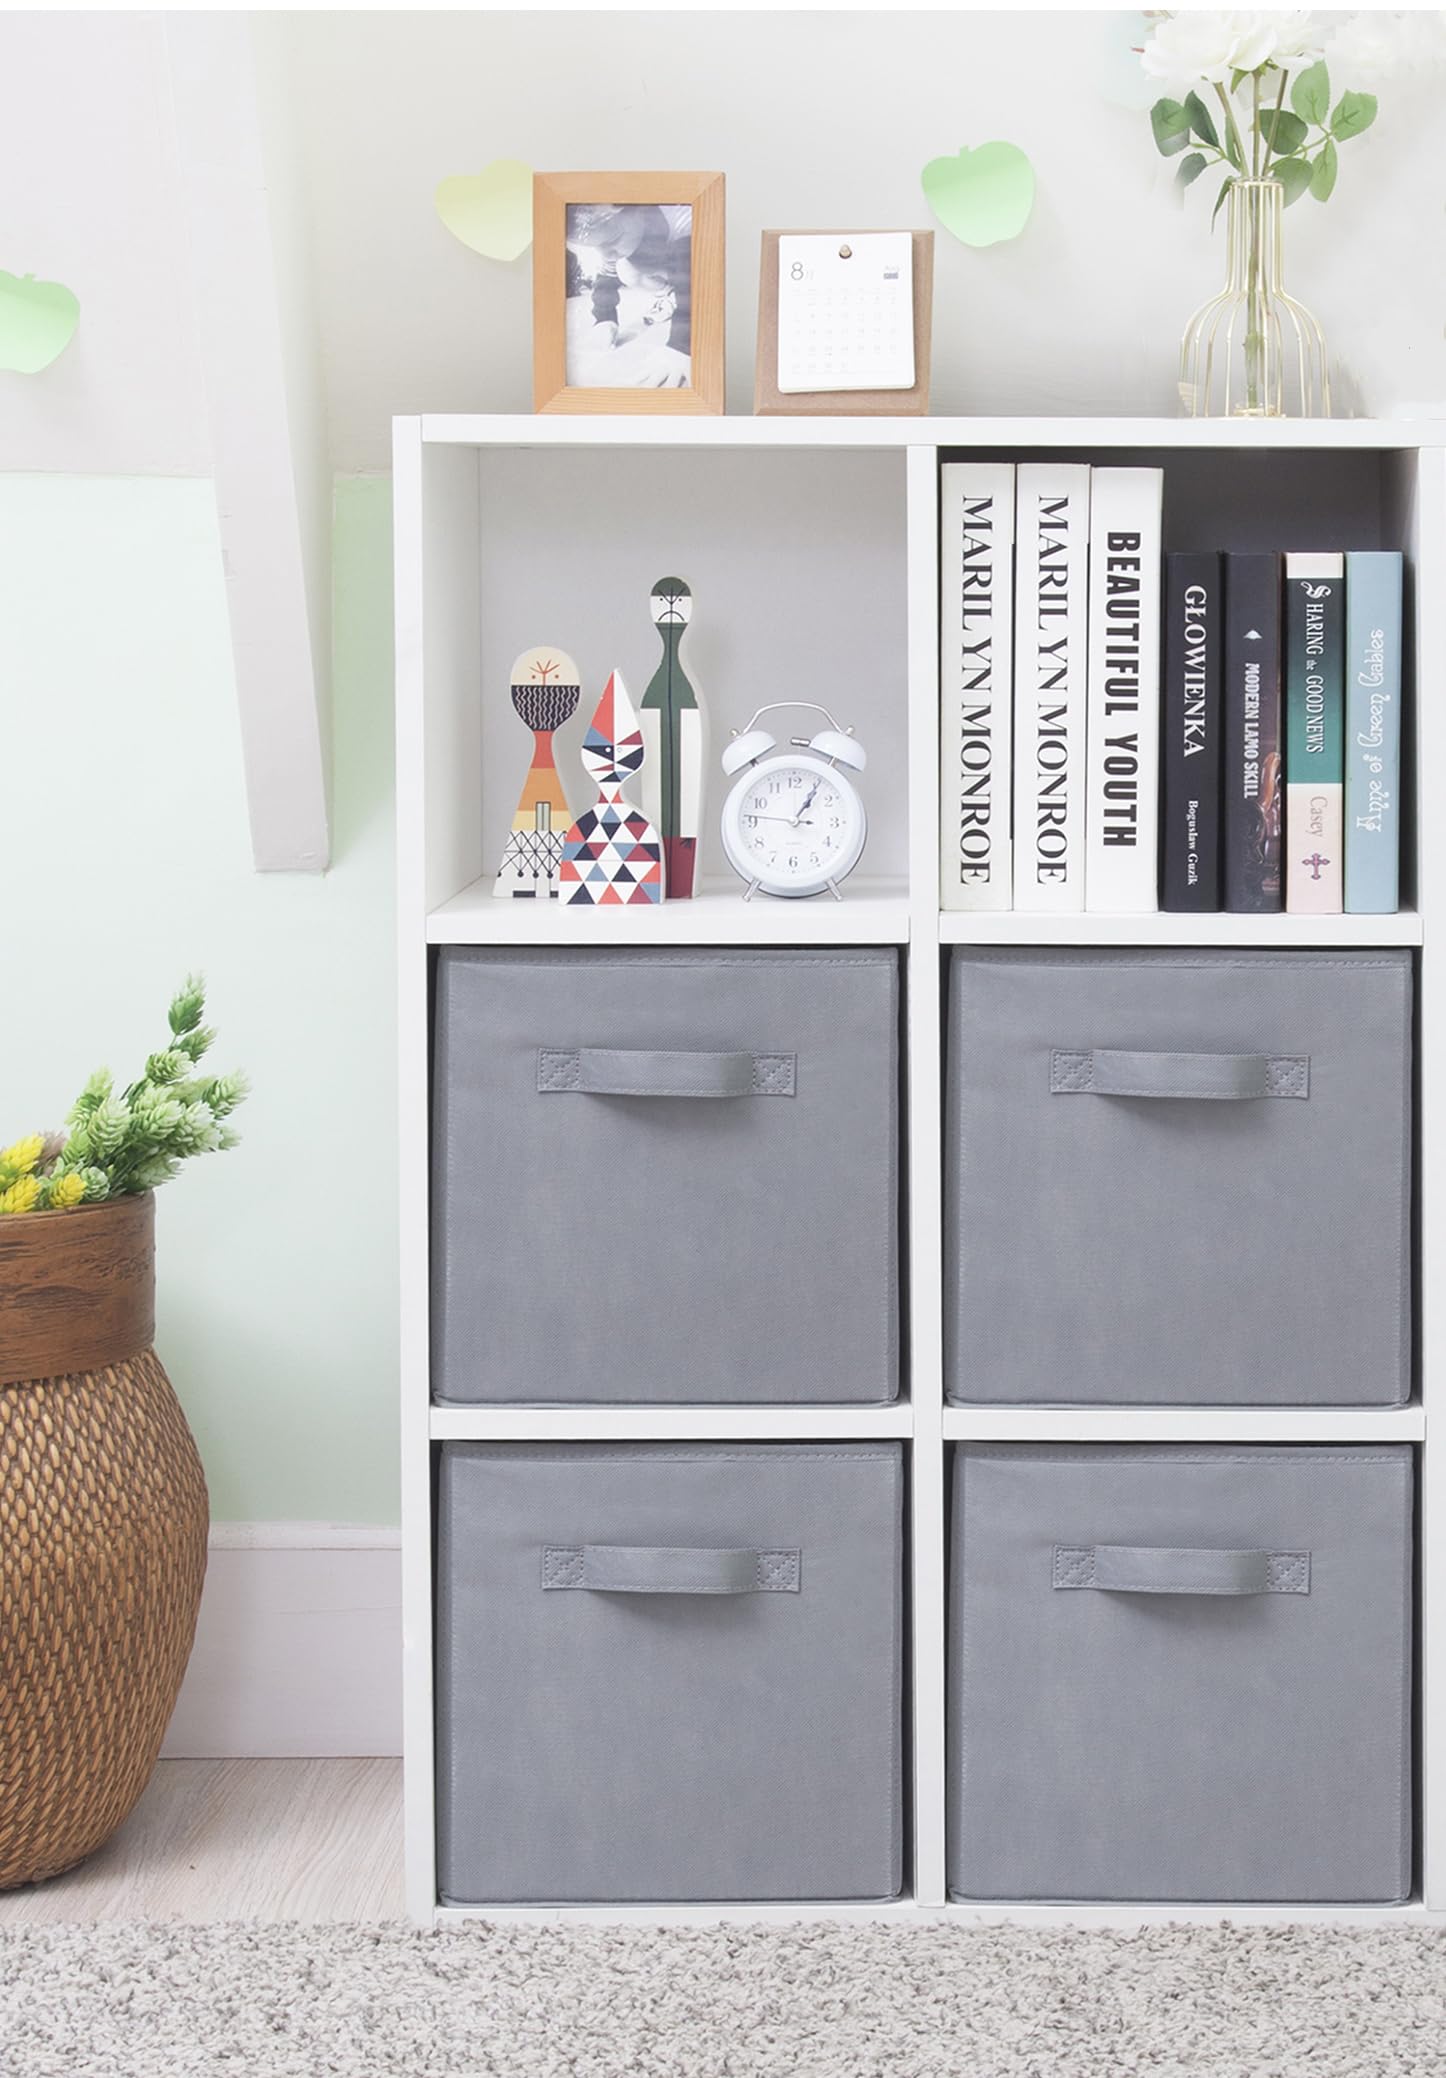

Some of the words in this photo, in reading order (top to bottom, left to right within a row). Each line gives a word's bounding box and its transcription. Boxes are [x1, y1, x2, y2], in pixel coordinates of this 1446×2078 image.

[791, 261, 804, 281] 8
[1105, 532, 1141, 716] BEAUTIFUL
[1184, 585, 1206, 757] GŁOWIENKA
[1358, 630, 1383, 686] Gables
[1245, 663, 1260, 719] MODERN
[1306, 675, 1325, 713] GOOD
[1306, 715, 1323, 752] NEWS
[1357, 694, 1390, 747] Green
[1244, 722, 1259, 759] LAMO
[1363, 755, 1382, 773] of
[769, 783, 780, 793] 11
[788, 777, 802, 788] 12
[960, 704, 991, 884] MONROE
[1037, 704, 1067, 884] MONROE
[1103, 733, 1138, 846] YOUTH
[1244, 762, 1262, 799] SKILL
[754, 798, 767, 809] 10
[824, 795, 833, 807] 2
[1310, 796, 1328, 838] Casey
[748, 816, 758, 828] 9
[830, 817, 839, 828] 3
[754, 837, 764, 848] 8
[769, 851, 776, 863] 7
[822, 836, 830, 847] 4
[789, 856, 798, 867] 6
[810, 852, 819, 864] 5
[1188, 853, 1198, 885] Guzik
